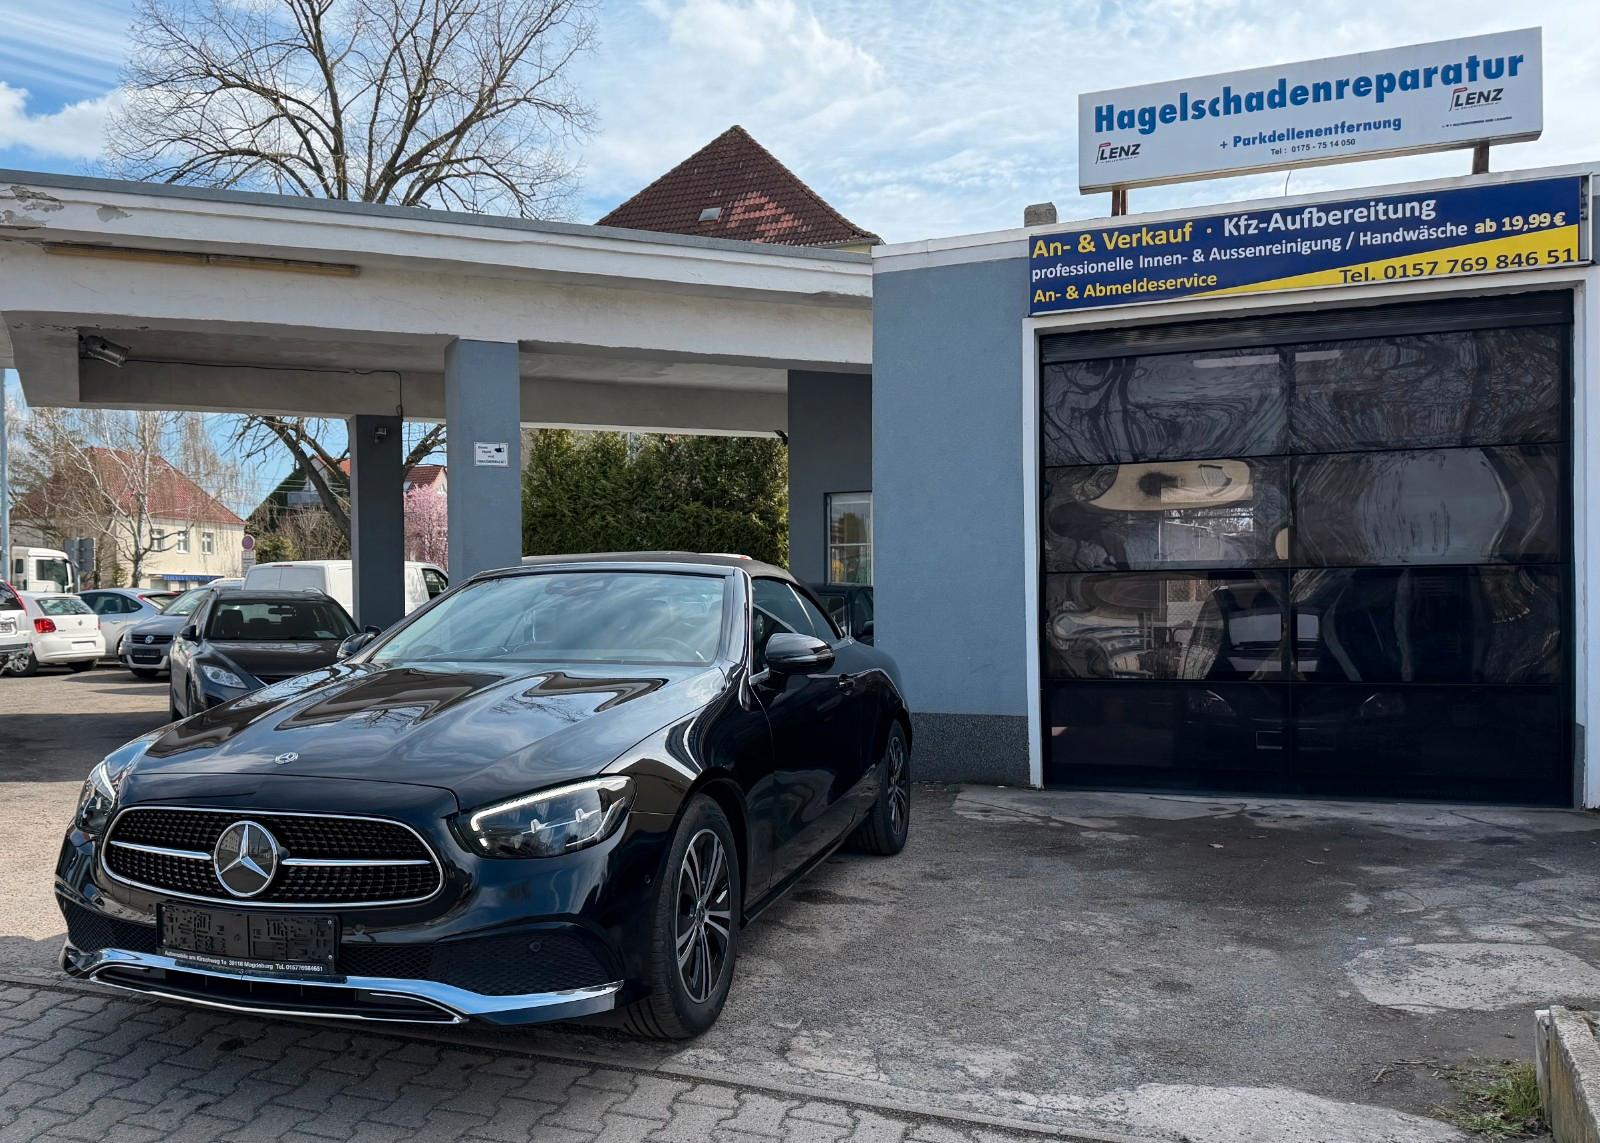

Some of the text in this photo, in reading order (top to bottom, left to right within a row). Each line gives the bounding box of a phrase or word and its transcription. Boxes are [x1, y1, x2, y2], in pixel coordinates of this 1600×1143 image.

[1094, 53, 1524, 136] Hagelschadenreparatur
[1453, 88, 1504, 108] LENZ
[1233, 117, 1402, 148] Parkdellenentfernung
[1291, 143, 1311, 153] 0175
[1317, 141, 1328, 149] 75
[1329, 139, 1340, 148] 14
[1341, 138, 1356, 146] 050
[1099, 143, 1141, 161] LENZ
[1032, 199, 1437, 259] An- & Verkauf Kfz-Aufbereitung
[1032, 256, 1134, 283] professionelle
[1139, 253, 1188, 269] Innen-
[1192, 248, 1205, 263] &
[1209, 236, 1342, 262] Aussenreinigung
[1359, 222, 1468, 247] Handwäsche
[1474, 218, 1497, 234] ab
[1338, 247, 1575, 284] Tel. 0157 769 846 51
[1033, 273, 1217, 304] An- & Abmeldeservice
